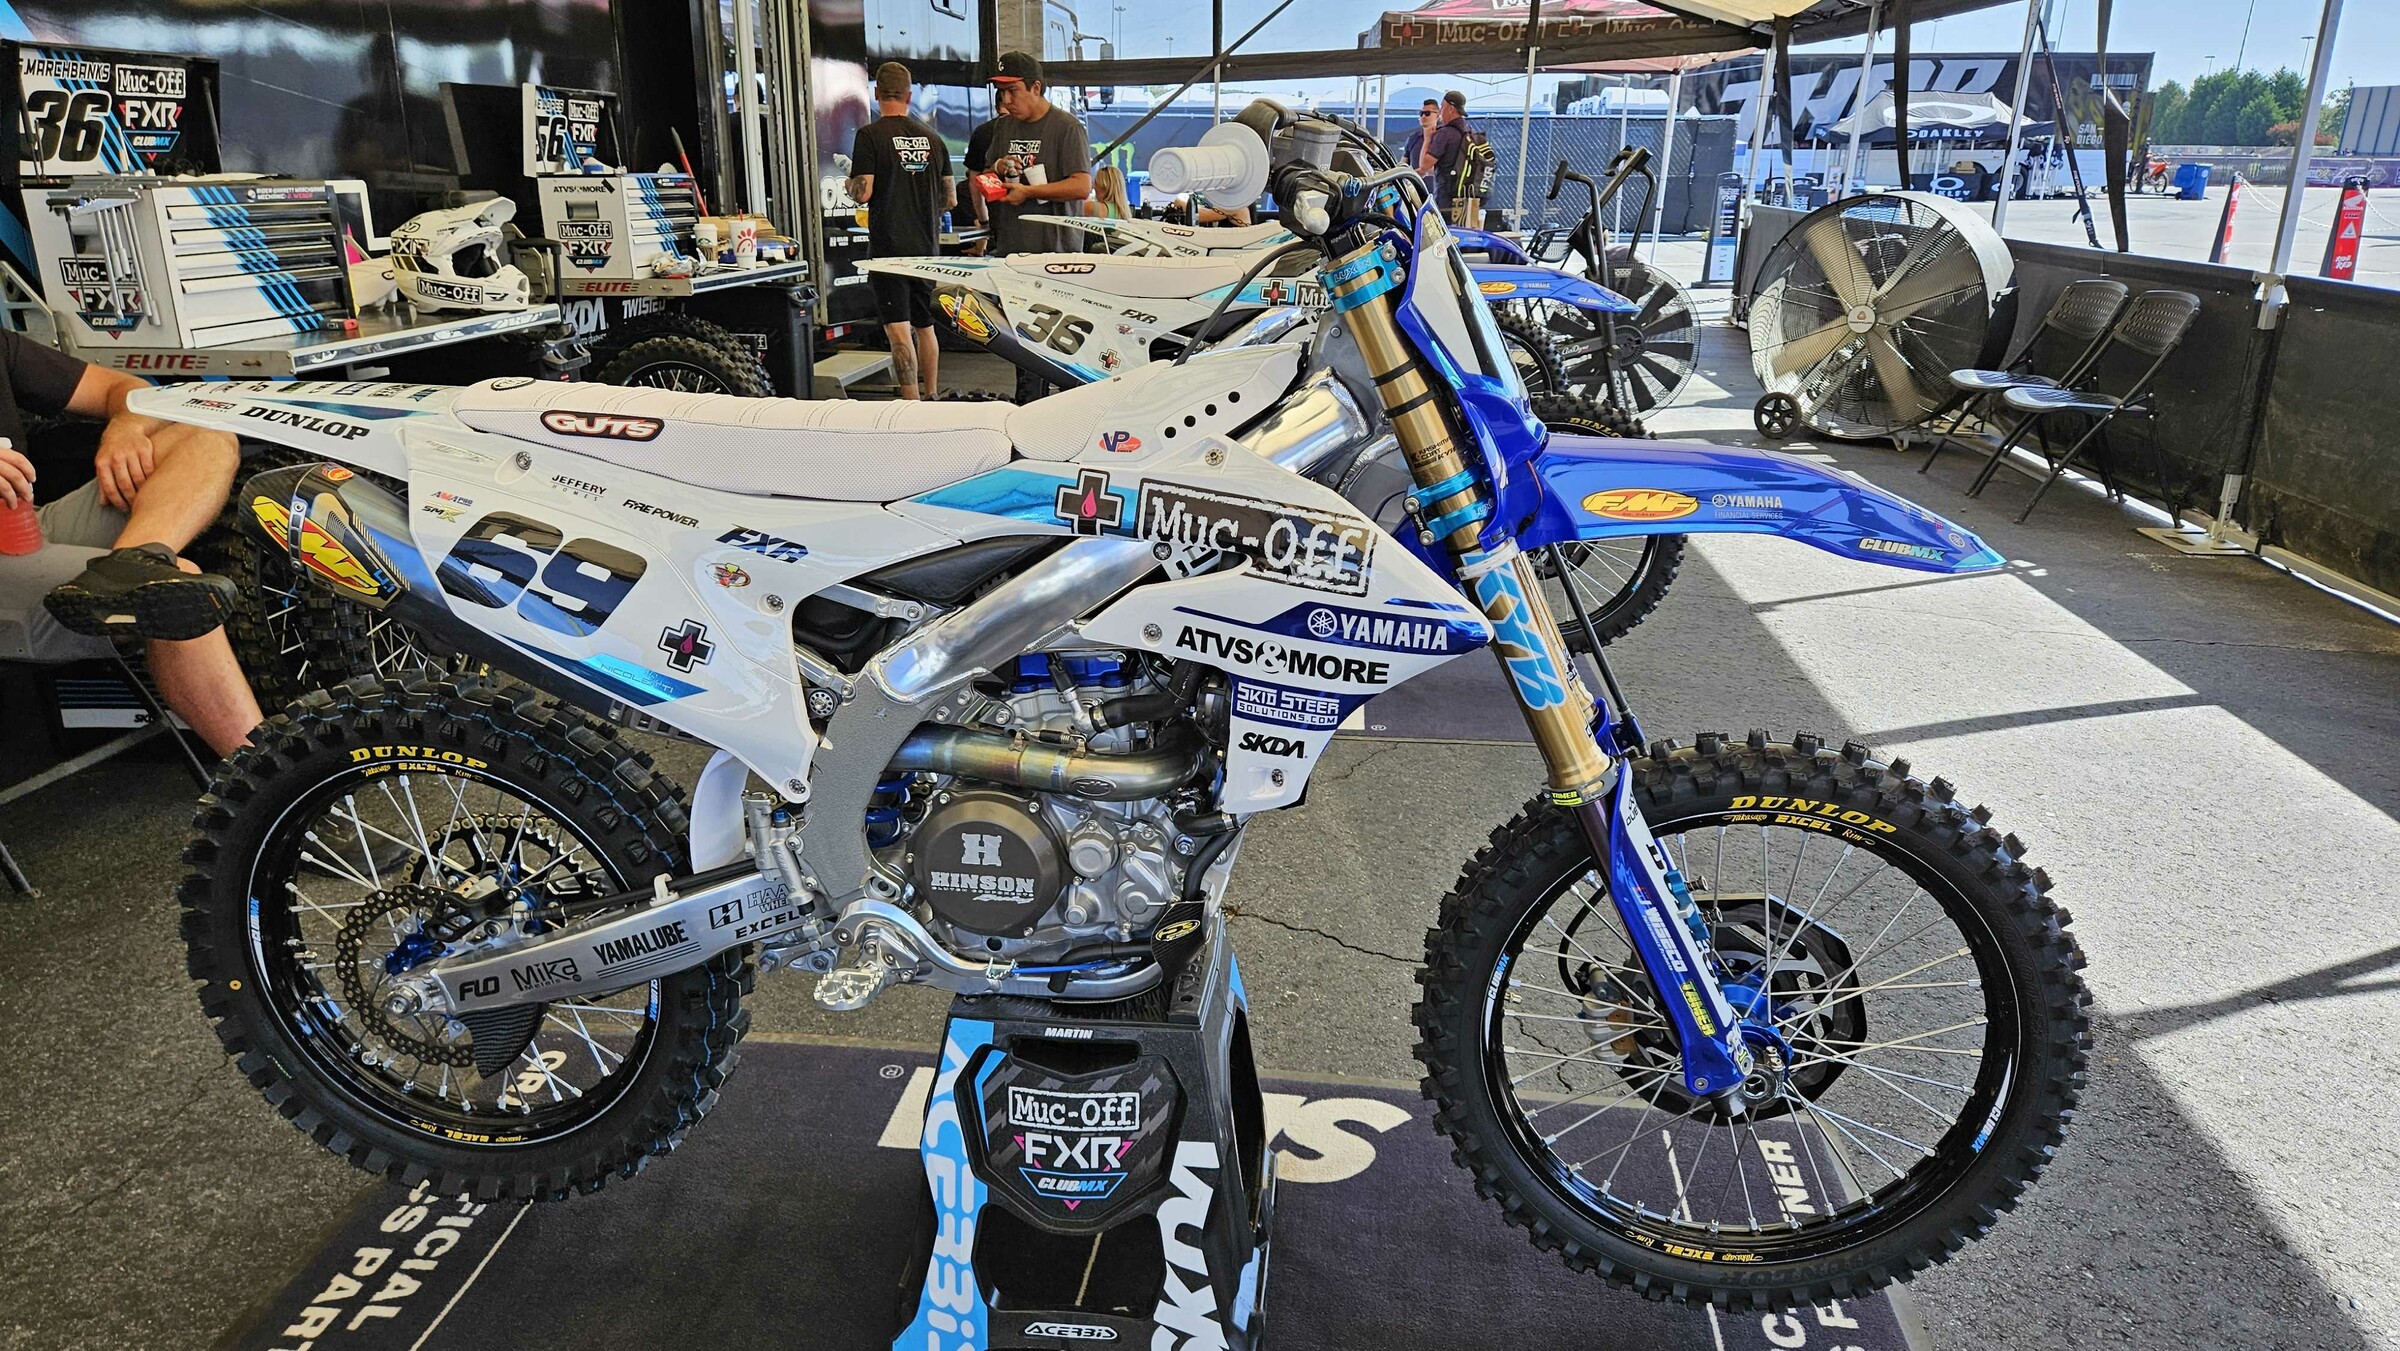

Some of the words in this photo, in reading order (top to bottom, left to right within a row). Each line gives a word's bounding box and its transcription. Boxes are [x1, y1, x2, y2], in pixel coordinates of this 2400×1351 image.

[1440, 20, 1530, 44] Muc-Of
[24, 57, 111, 83] MARCHBANKS
[118, 68, 184, 96] Muc-Off
[20, 89, 112, 162] 36
[124, 100, 177, 128] FXR
[132, 135, 171, 146] CLUBMX
[572, 123, 597, 142] FXR
[1918, 129, 1985, 139] OAKLEY
[2076, 134, 2103, 145] DIEGO
[2079, 123, 2097, 134] SAN
[900, 150, 928, 162] FXR
[561, 224, 610, 237] Muc-Off
[569, 240, 608, 254] FXR
[914, 264, 972, 279] DUNLOP
[1047, 263, 1094, 274] GUTS
[420, 281, 479, 303] Muc-Off
[584, 282, 632, 293] ELITE
[1119, 308, 1158, 325] FXR
[1015, 303, 1094, 356] 36
[126, 354, 196, 370] ELITE
[240, 406, 371, 441] DUNLOP
[544, 413, 659, 438] GUTS
[1102, 430, 1131, 453] VP
[551, 474, 607, 495] JEFFERY
[551, 484, 600, 502] HOMES
[1583, 492, 1697, 513] FMF
[1728, 494, 1784, 508] YAMAHA
[1714, 511, 1750, 520] FINANCIAL
[1750, 511, 1784, 520] SERVICES
[715, 523, 809, 563] FXR
[1151, 496, 1363, 582] Muc-Off
[1858, 537, 1945, 562] CLUBMX
[436, 510, 648, 638] 69
[1340, 613, 1448, 650] YAMAHA
[1175, 625, 1390, 685] ATVS&MORE
[1237, 682, 1277, 706] SKID
[1281, 691, 1340, 715] STEER
[1238, 702, 1338, 726] SOLUTIONS.COM
[350, 745, 488, 769] DUNLOP
[1238, 732, 1305, 760] SKDA
[1728, 795, 1898, 834] DUNLOP
[1724, 813, 1768, 823] Takasago
[1774, 813, 1833, 832] EXCEL
[1842, 828, 1868, 844] Rim
[961, 832, 1003, 867] H
[931, 871, 1035, 893] HINSON
[747, 883, 791, 909] HAA
[735, 911, 800, 939] EXCEL
[592, 921, 690, 967] YAMALUBE
[1644, 907, 1689, 973] WISECO
[510, 957, 579, 992] Mika
[1488, 952, 1510, 1000] CLUBMX
[459, 976, 500, 1001] FLO
[1681, 980, 1716, 1036] TAMER
[1044, 1027, 1094, 1039] MARTIN
[1014, 1092, 1135, 1127] Muc-Off
[1971, 1105, 2002, 1154] CLUBMX
[1025, 1132, 1122, 1169] FXR
[1037, 1176, 1109, 1193] CLUBMX
[1663, 1243, 1714, 1261] EXCEL
[1722, 1252, 1763, 1263] Takasago
[1024, 1323, 1115, 1340] ACERBIS
